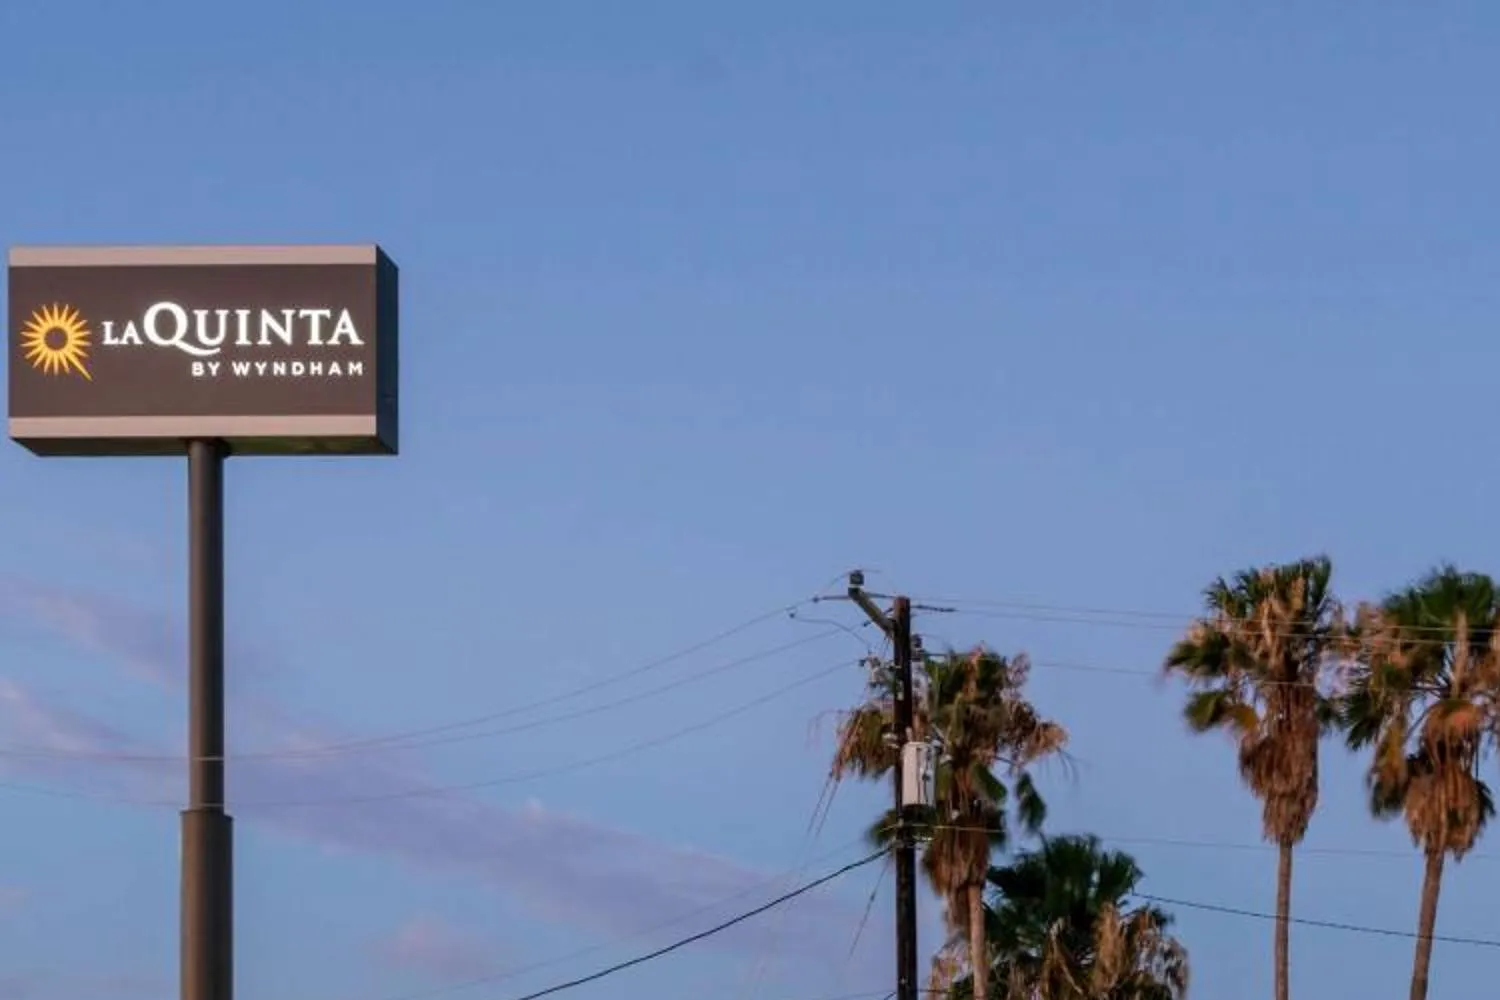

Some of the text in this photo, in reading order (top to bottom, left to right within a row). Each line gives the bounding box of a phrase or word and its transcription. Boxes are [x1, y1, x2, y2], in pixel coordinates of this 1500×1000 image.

[143, 301, 365, 357] QUINTA
[191, 361, 364, 377] BY WYNDHAM
